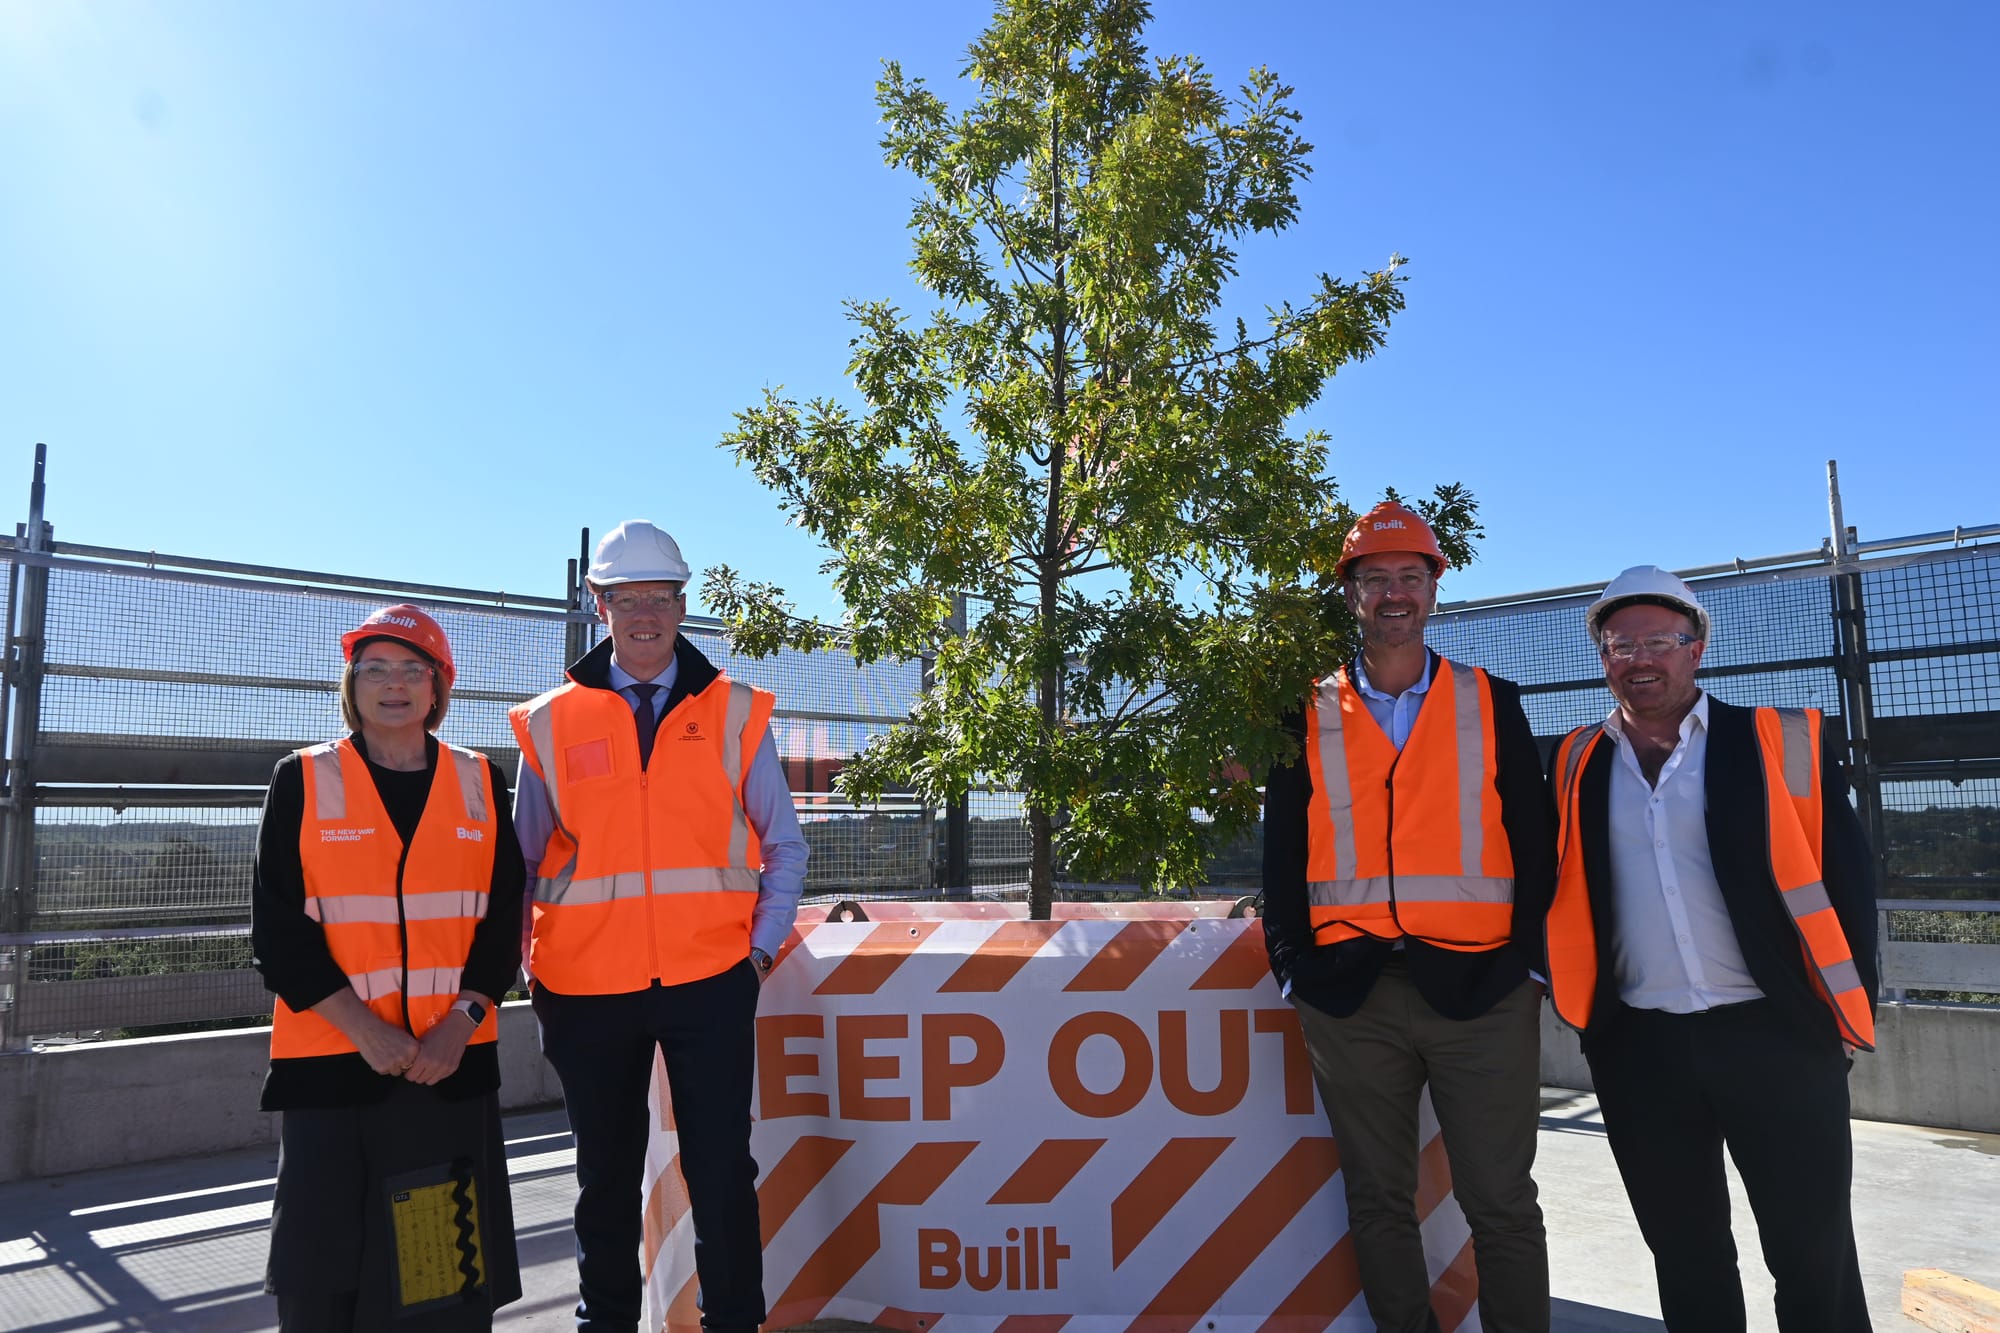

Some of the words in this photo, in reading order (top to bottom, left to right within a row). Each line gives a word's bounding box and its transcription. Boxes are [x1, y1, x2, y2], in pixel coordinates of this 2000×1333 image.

[1373, 520, 1407, 531] Built
[378, 613, 417, 629] Built
[456, 827, 484, 842] Built
[1047, 1008, 1316, 1118] OUT
[918, 1226, 1070, 1291] Built
